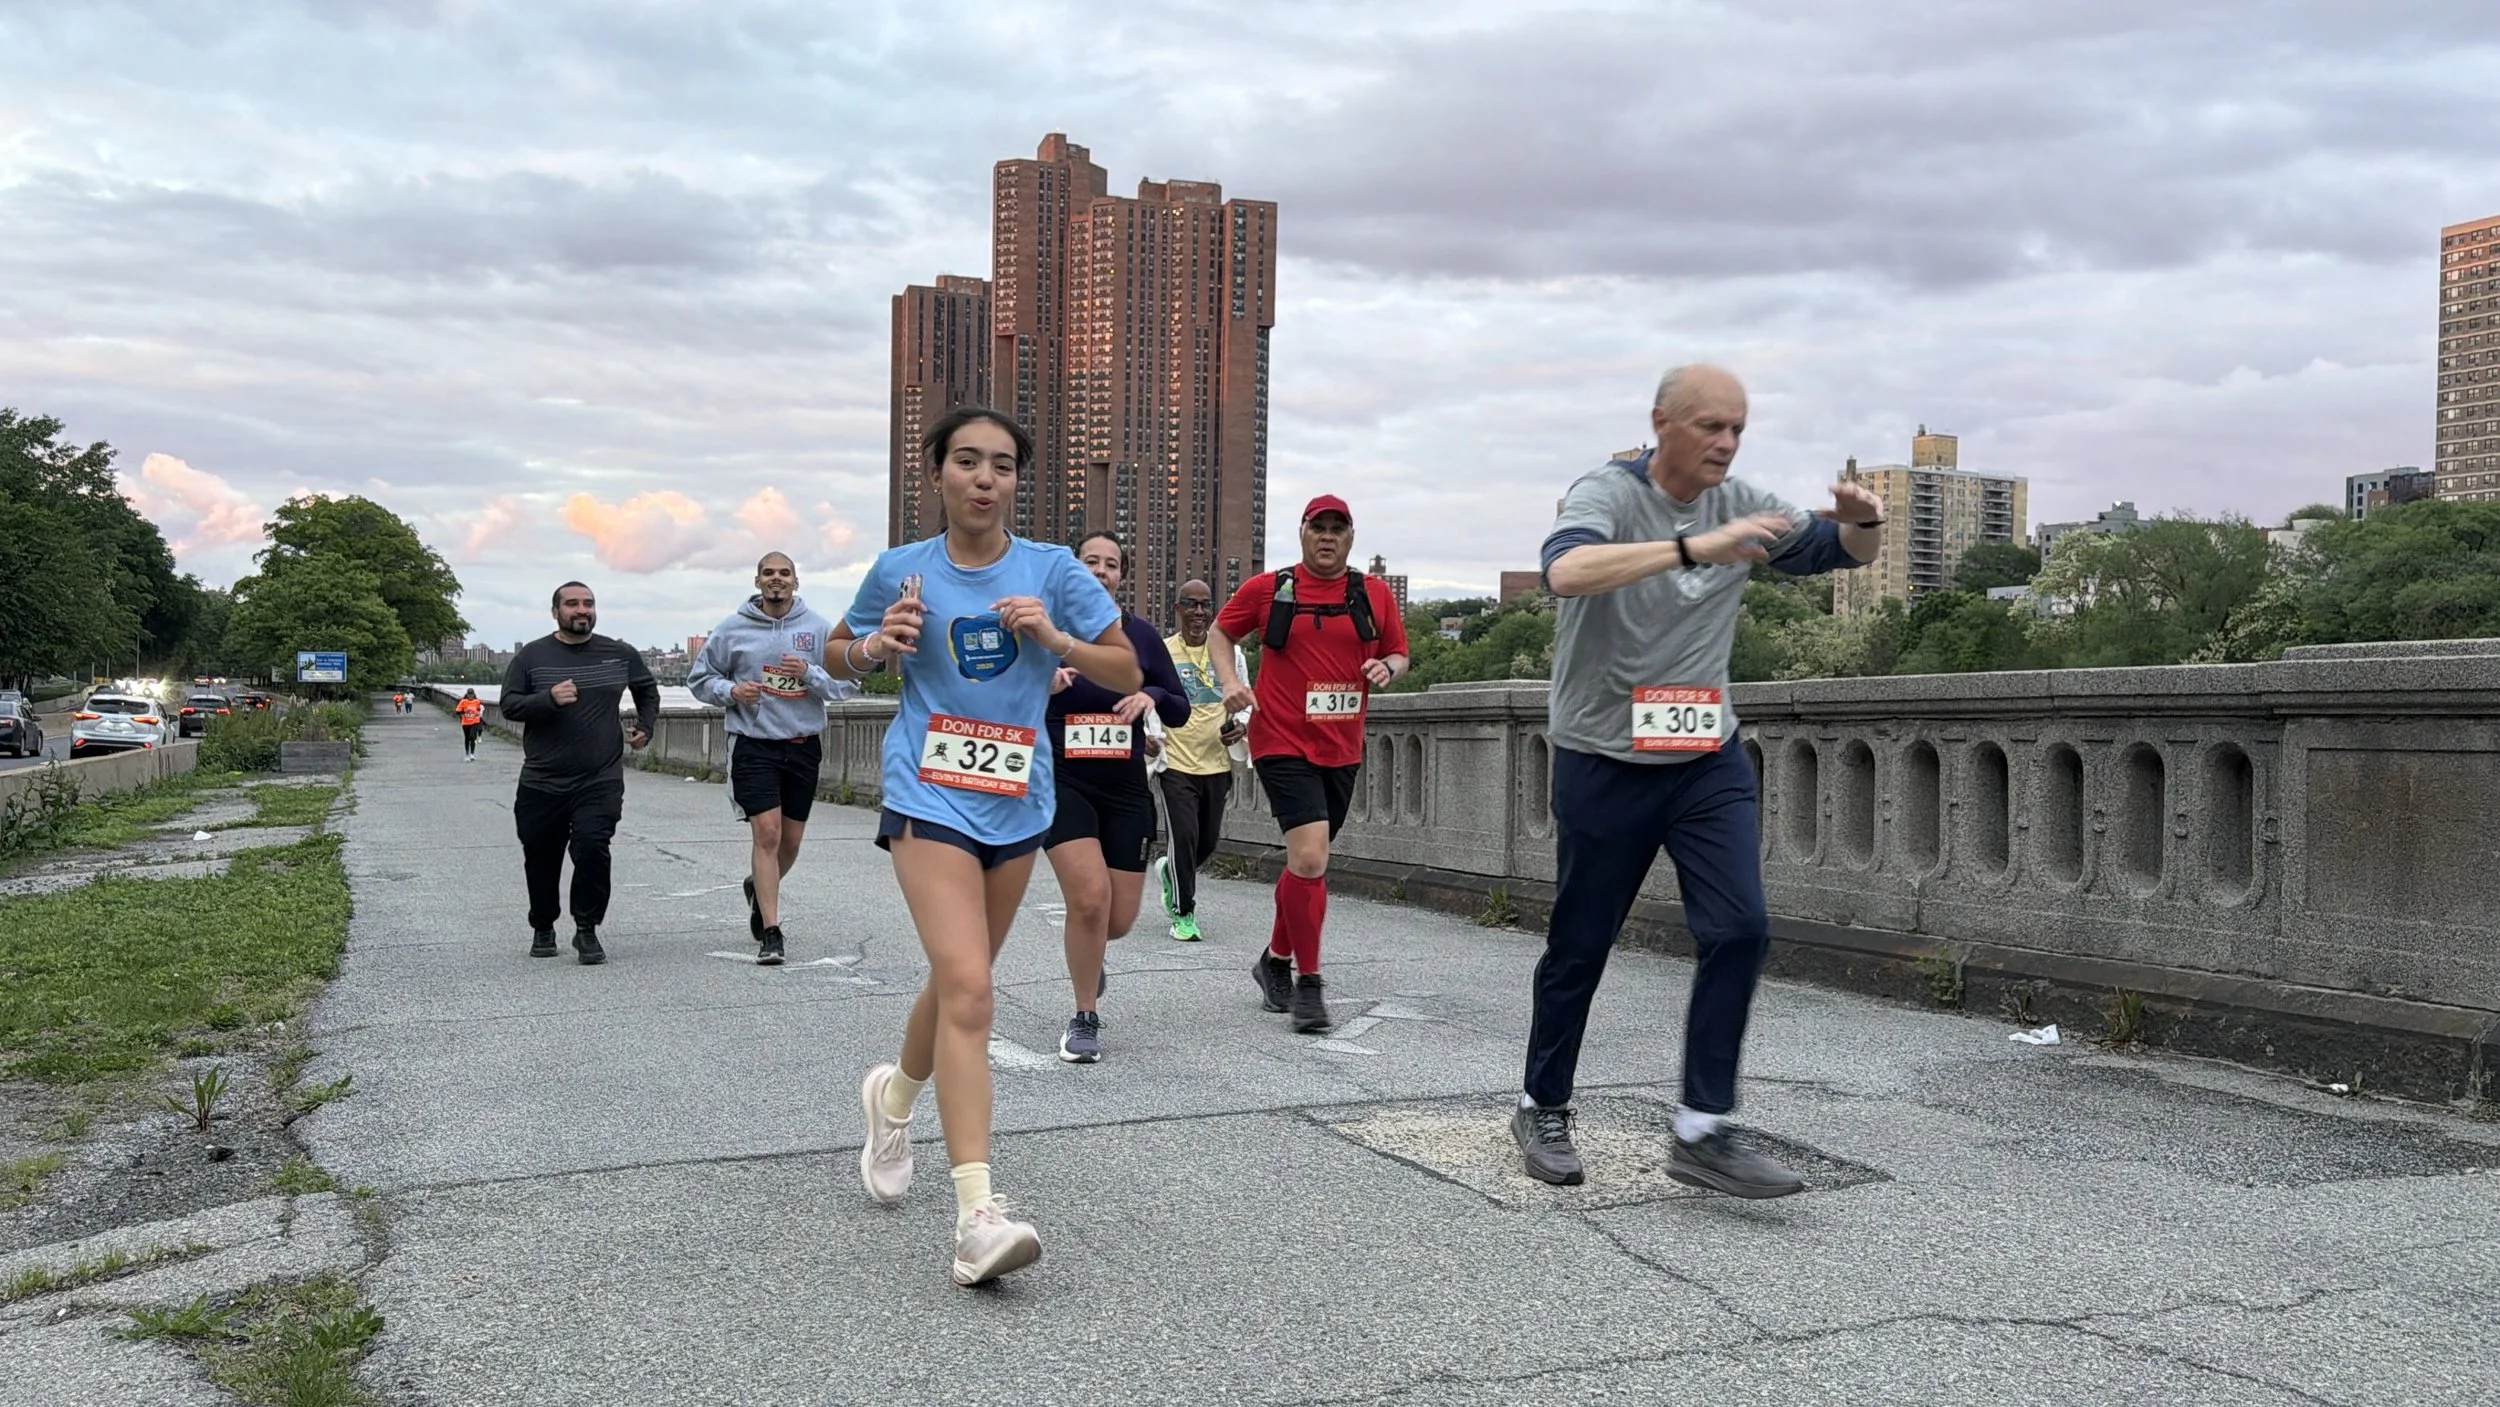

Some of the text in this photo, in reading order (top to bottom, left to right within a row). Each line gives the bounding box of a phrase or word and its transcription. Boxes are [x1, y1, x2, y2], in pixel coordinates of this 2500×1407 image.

[778, 677, 796, 690] 22
[1327, 693, 1345, 711] 31
[1073, 715, 1094, 724] DON
[1666, 706, 1698, 734] 30
[942, 718, 975, 736] DON
[1005, 728, 1024, 743] 5K
[1089, 727, 1112, 746] 14
[958, 740, 999, 774] 32
